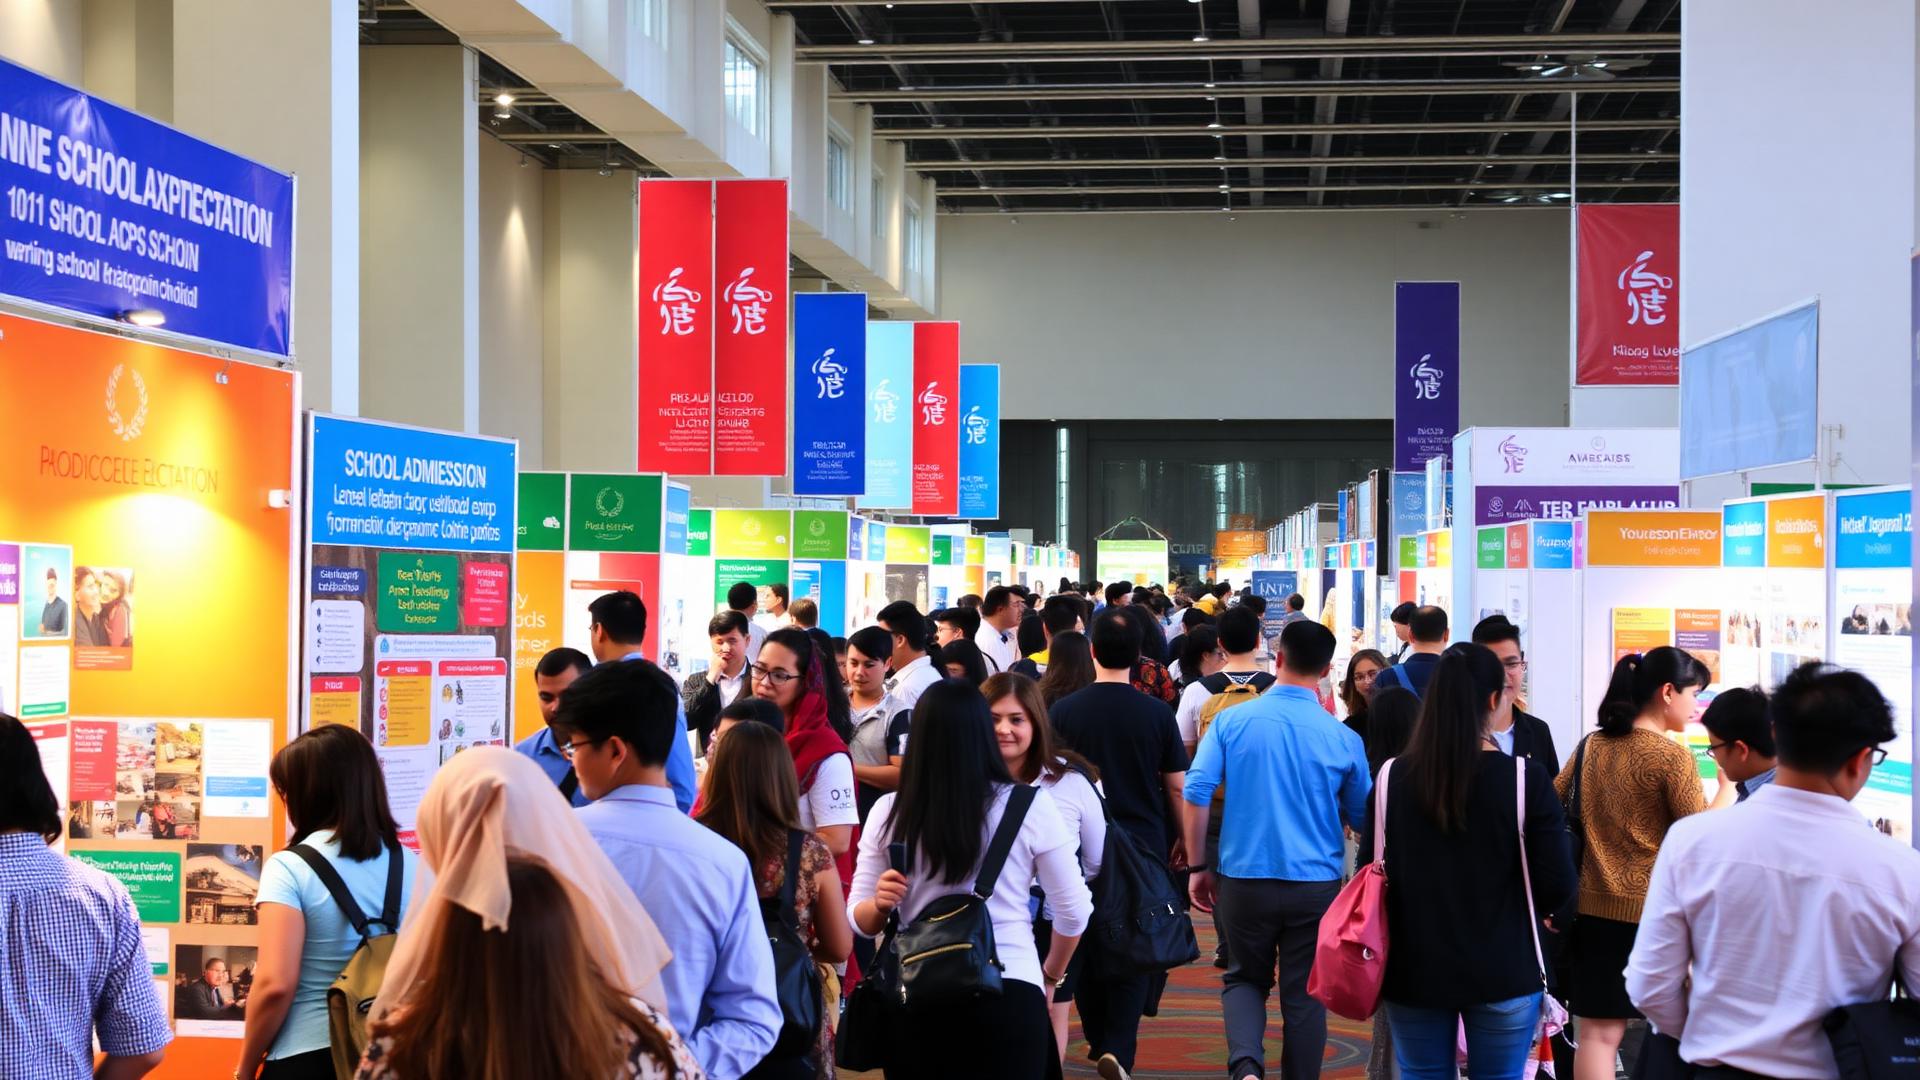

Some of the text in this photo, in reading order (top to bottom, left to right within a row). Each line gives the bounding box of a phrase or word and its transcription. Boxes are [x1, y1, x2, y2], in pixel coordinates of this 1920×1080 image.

[1, 112, 52, 174] NNE
[7, 185, 44, 226] 1011
[344, 448, 401, 481] SCHOOL
